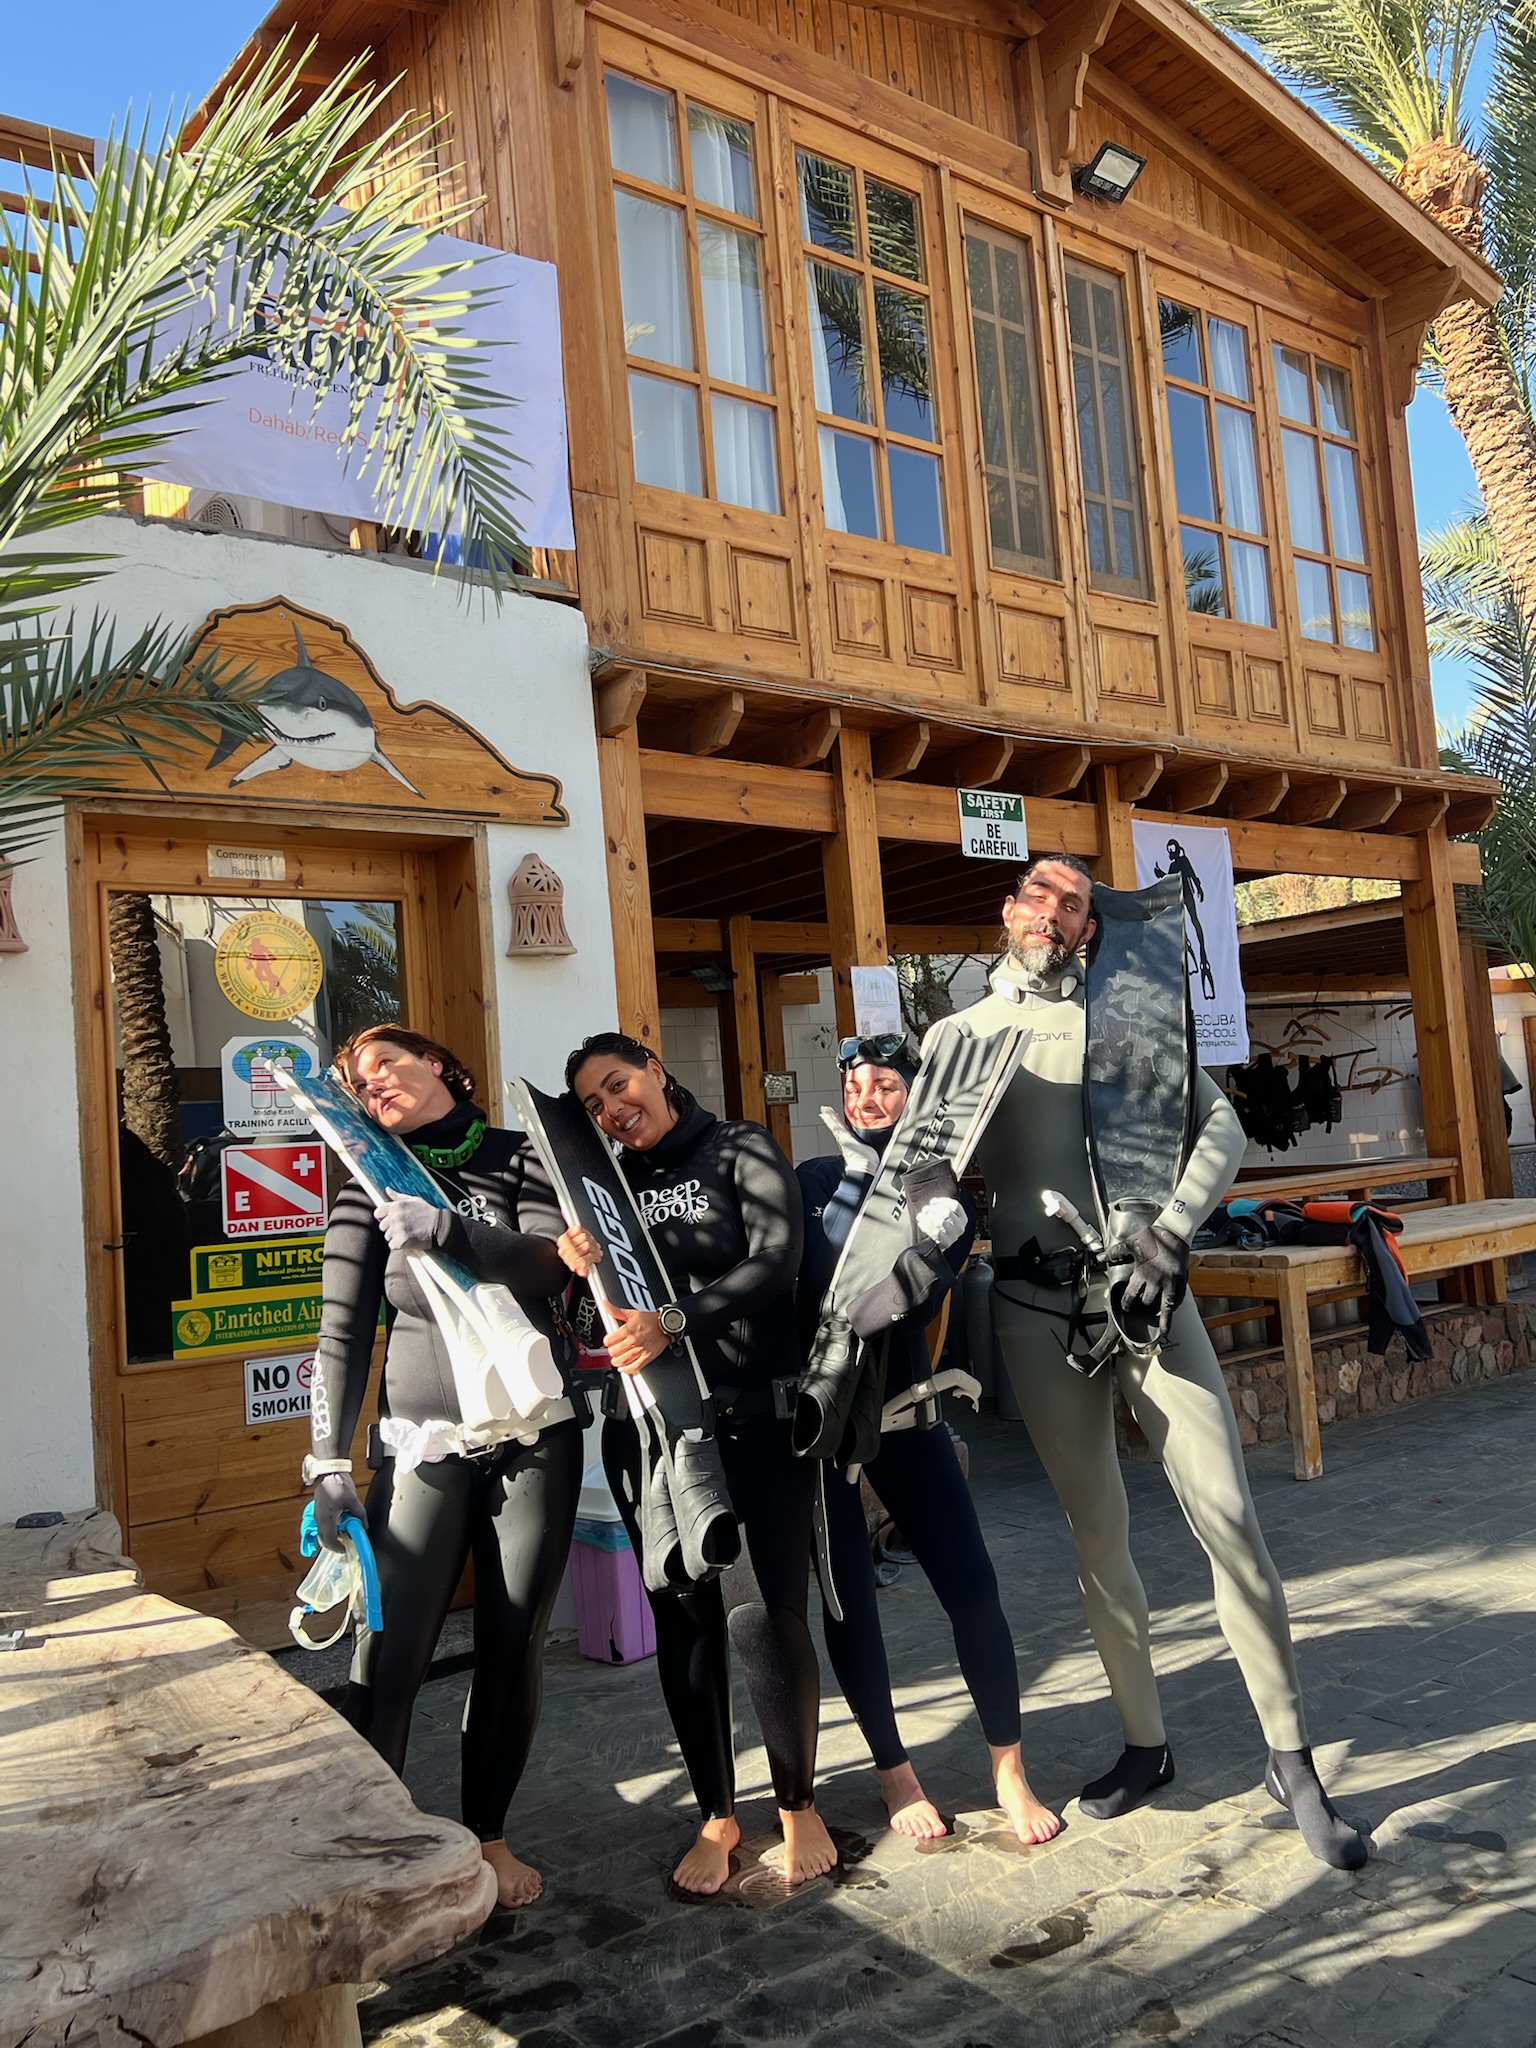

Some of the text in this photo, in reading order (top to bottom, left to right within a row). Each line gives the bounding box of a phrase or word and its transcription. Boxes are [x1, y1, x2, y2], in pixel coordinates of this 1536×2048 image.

[249, 407, 309, 440] Dahab,
[966, 794, 1016, 811] SAFETY
[980, 809, 1005, 819] FIRST
[986, 823, 1002, 839] BE
[216, 849, 273, 862] Compressor
[971, 838, 1020, 857] CAREFUL
[231, 866, 260, 877] Room
[229, 914, 265, 936] NITROX
[275, 916, 309, 942] TRIMIX
[220, 972, 243, 1006] WRECK
[304, 979, 319, 1003] CAVE
[252, 1007, 278, 1019] DEEP
[281, 1006, 299, 1018] AIR
[1195, 1028, 1237, 1039] SCHOOLS
[278, 1108, 294, 1116] East
[228, 1119, 275, 1129] TRAINING
[234, 1190, 251, 1213] E
[637, 1179, 701, 1209] Deep
[641, 1194, 710, 1230] Roots
[227, 1216, 325, 1234] DAN EUROPE
[257, 1267, 286, 1277] Technical
[213, 1304, 293, 1331] Enriched
[215, 1328, 260, 1340] INTERNATIONAL
[260, 1325, 298, 1336] ASSOCIATION
[298, 1323, 306, 1332] OF
[252, 1364, 290, 1394] NO
